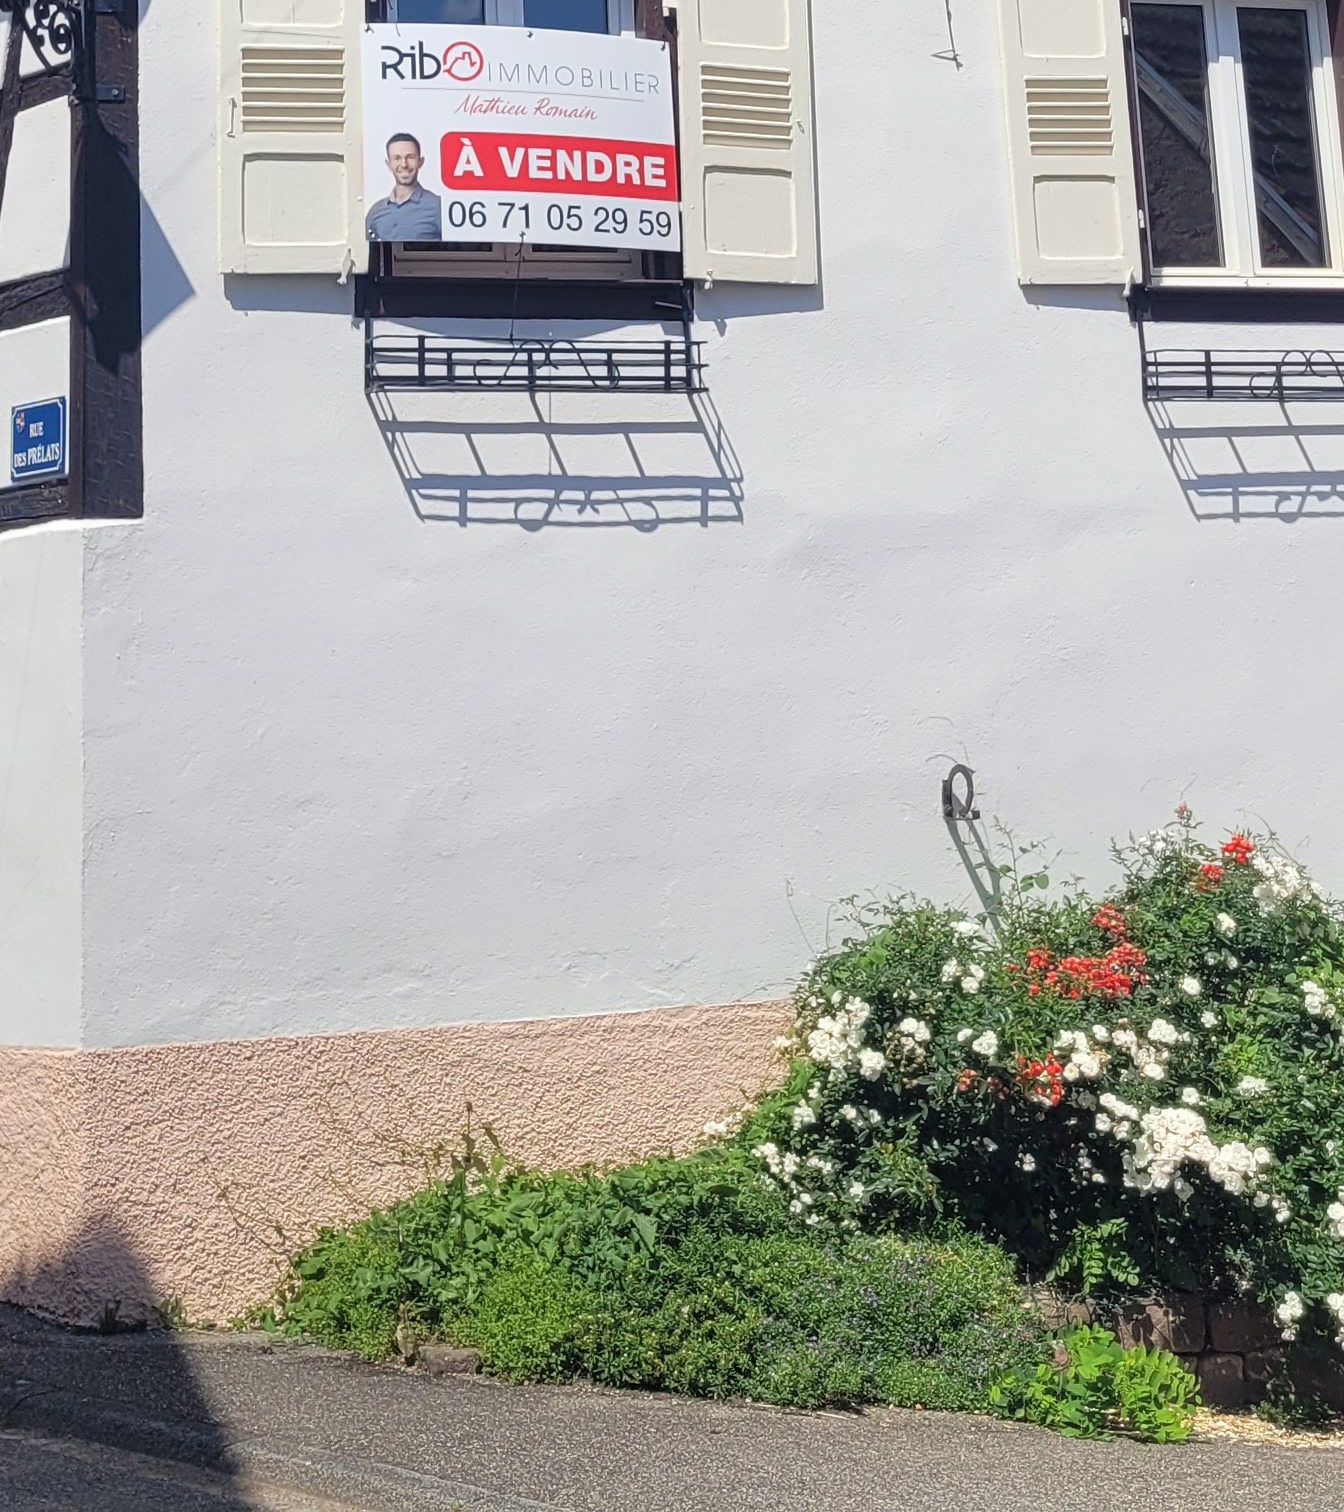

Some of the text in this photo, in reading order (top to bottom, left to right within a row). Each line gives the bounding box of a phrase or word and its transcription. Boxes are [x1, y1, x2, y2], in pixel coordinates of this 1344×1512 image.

[487, 62, 660, 94] IMMOBILIER
[454, 93, 598, 120] Mathieu Romain
[453, 137, 667, 188] À VENDRE
[448, 201, 672, 237] 06 71 05 29 59
[29, 421, 44, 438] RUE
[14, 443, 60, 468] DES PRÉLATS
